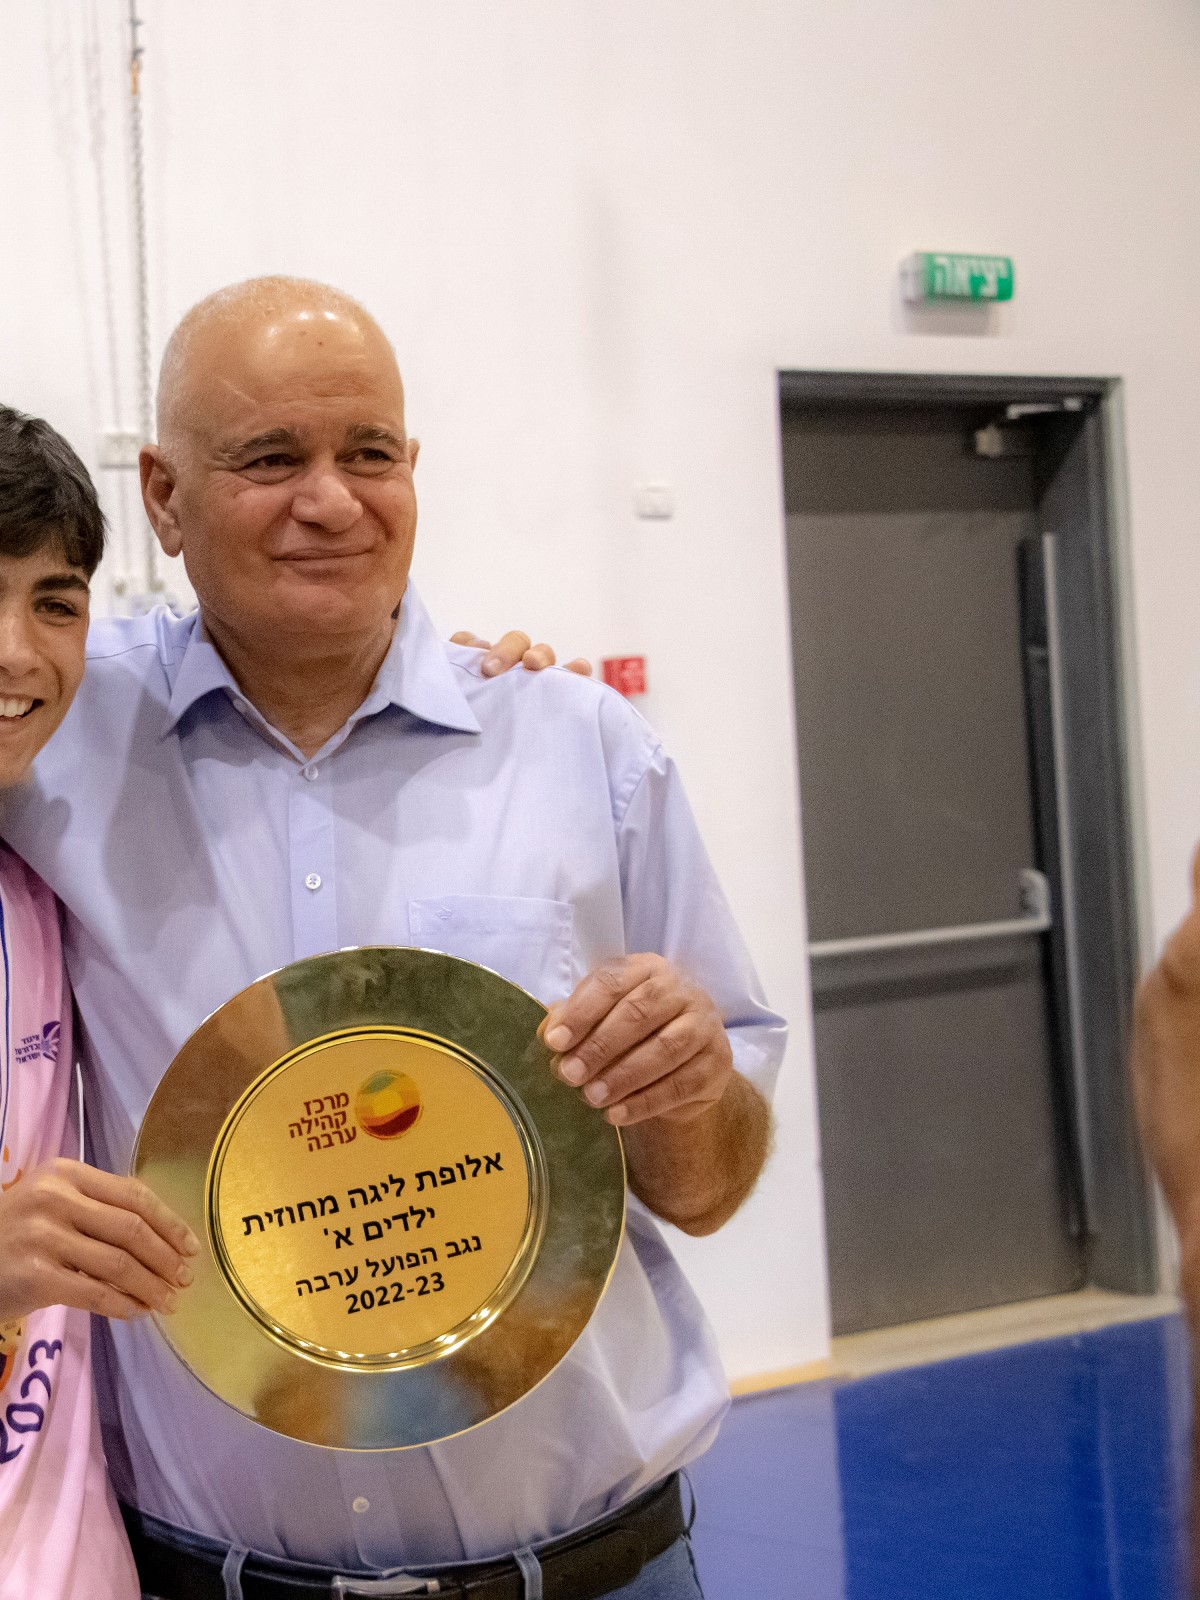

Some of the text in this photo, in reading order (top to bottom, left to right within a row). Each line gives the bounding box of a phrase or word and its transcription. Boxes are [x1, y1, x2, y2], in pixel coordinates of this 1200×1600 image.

[933, 256, 1008, 297] יציאה
[304, 1093, 349, 1116] מרכז
[289, 1111, 346, 1138] קהילה
[307, 1126, 356, 1152] ערבה
[242, 1152, 504, 1235] אלופת ליגה מחוזית
[363, 1206, 435, 1241] ילדים
[296, 1236, 481, 1296] נגב הפועל ערבה
[346, 1272, 444, 1314] 2022-23
